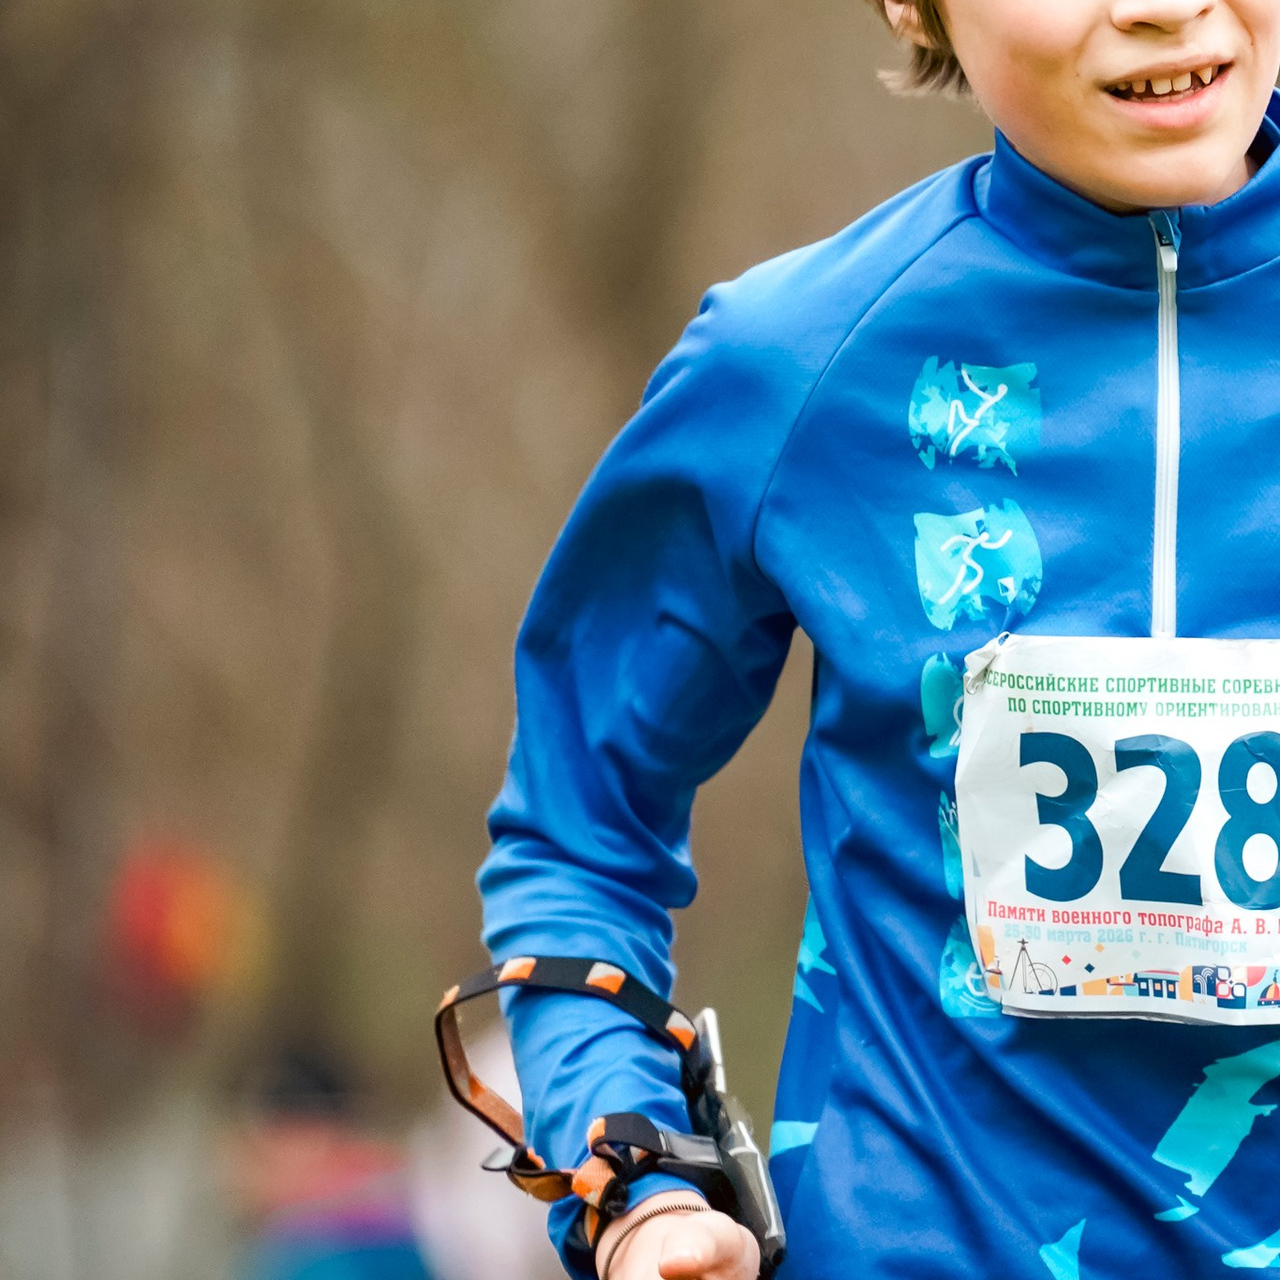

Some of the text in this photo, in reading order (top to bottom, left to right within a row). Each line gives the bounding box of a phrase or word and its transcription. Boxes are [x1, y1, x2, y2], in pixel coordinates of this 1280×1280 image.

[984, 670, 1099, 692] СЕРОССИЙСКИЕ
[1105, 677, 1216, 694] СПОРТИВНЫЕ
[1007, 697, 1027, 713] ПО
[1032, 699, 1148, 717] СПОРТИВНОМУ
[988, 901, 1046, 922] Памяти
[1052, 910, 1132, 925] военного
[1138, 912, 1223, 937] топографа
[1231, 918, 1247, 935] А.
[1255, 918, 1271, 935] В.
[1004, 924, 1247, 955] 25-30 марта 2026 г. г. Пятигорск
